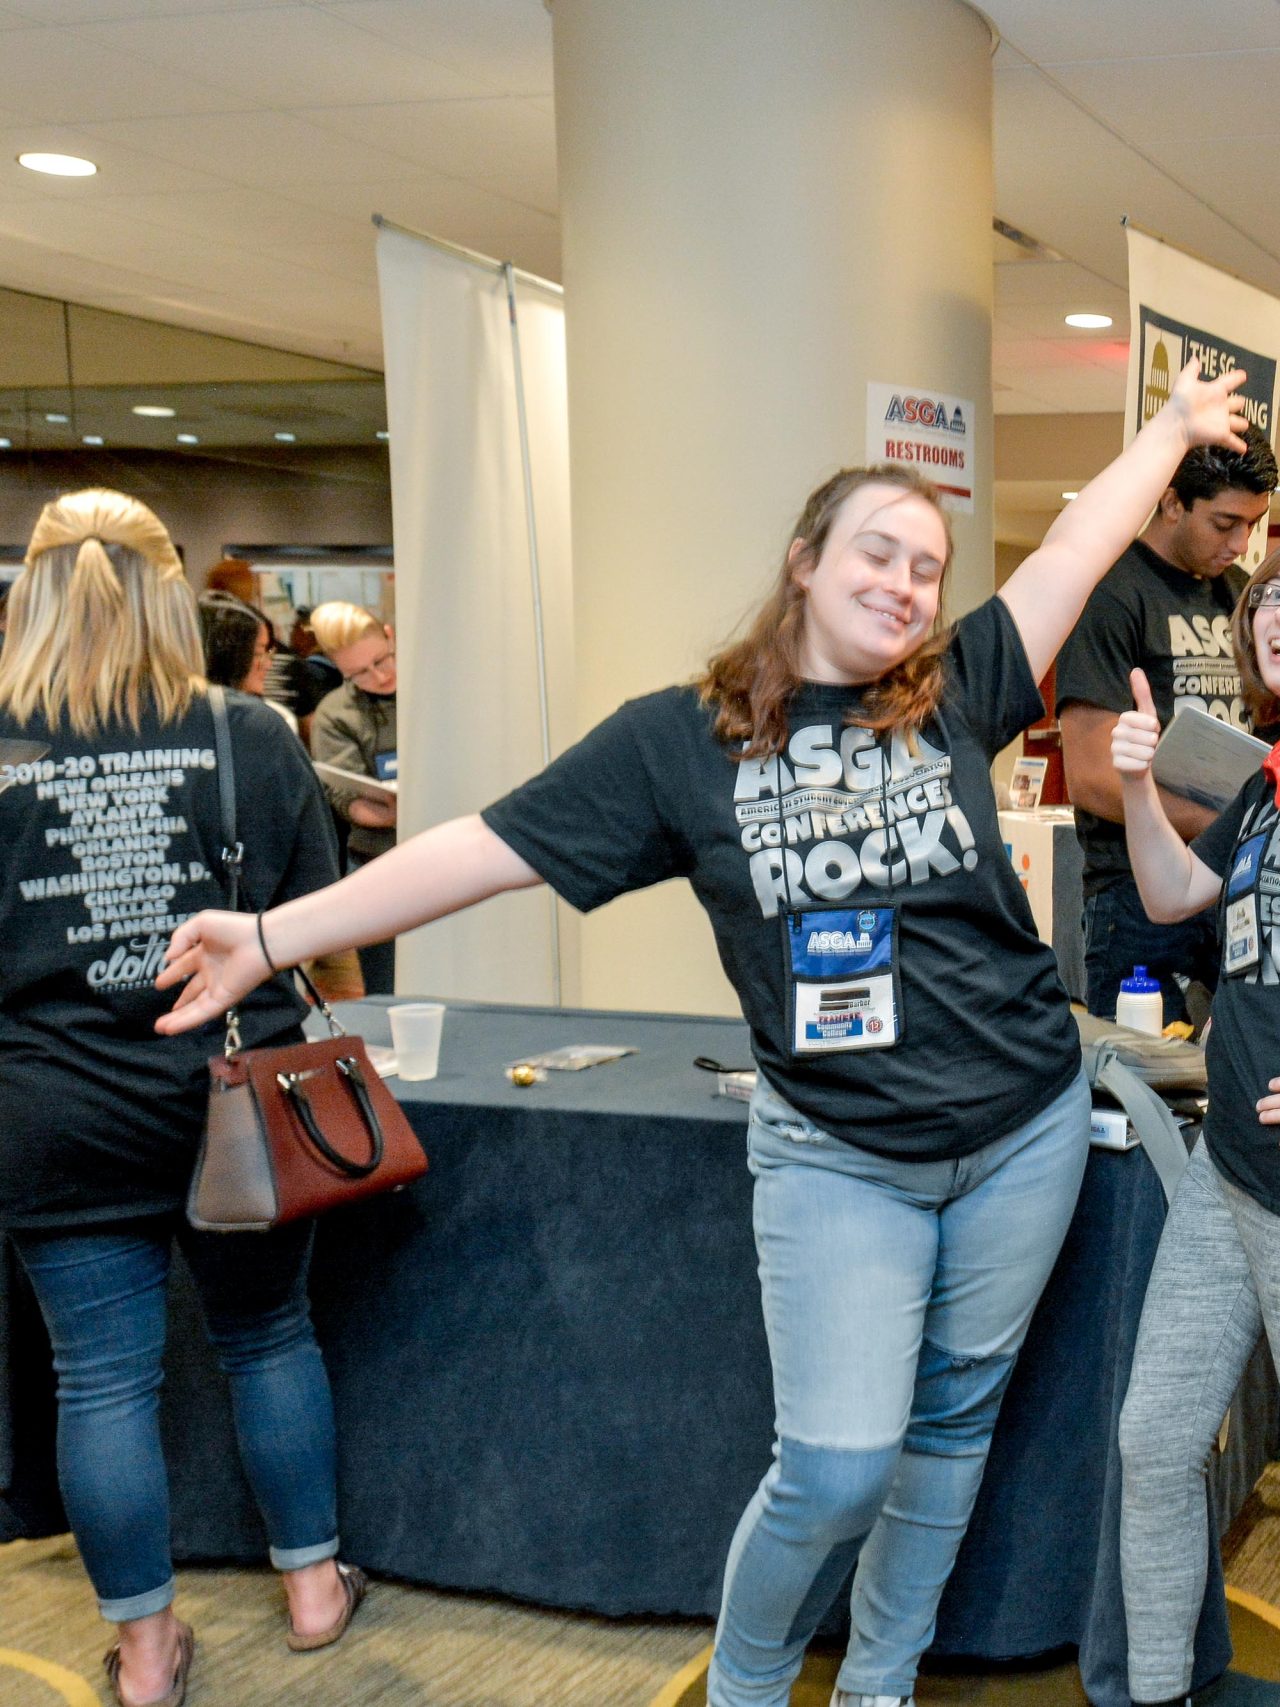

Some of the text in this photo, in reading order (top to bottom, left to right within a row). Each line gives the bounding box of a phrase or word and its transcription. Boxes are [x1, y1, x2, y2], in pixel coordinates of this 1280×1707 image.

[885, 394, 950, 430] ASGA
[885, 439, 965, 469] RESTROOMS
[1168, 614, 1235, 657] ASG
[98, 748, 216, 773] TRAINING
[734, 724, 947, 802] ASGA
[36, 769, 185, 800] NEW ORLEANS
[58, 786, 169, 813] NEW YORK
[70, 803, 164, 826] ATLANTA
[45, 816, 188, 847] PHILADELPHIA
[71, 834, 172, 858] ORLANDO
[80, 850, 165, 871] BOSTON
[749, 804, 979, 920] ROCK!
[19, 863, 187, 901] WASHINGTON,
[84, 885, 176, 909] CHICAGO
[90, 900, 169, 923] DALLAS
[66, 923, 106, 944] LOS
[807, 931, 857, 950] ASGA
